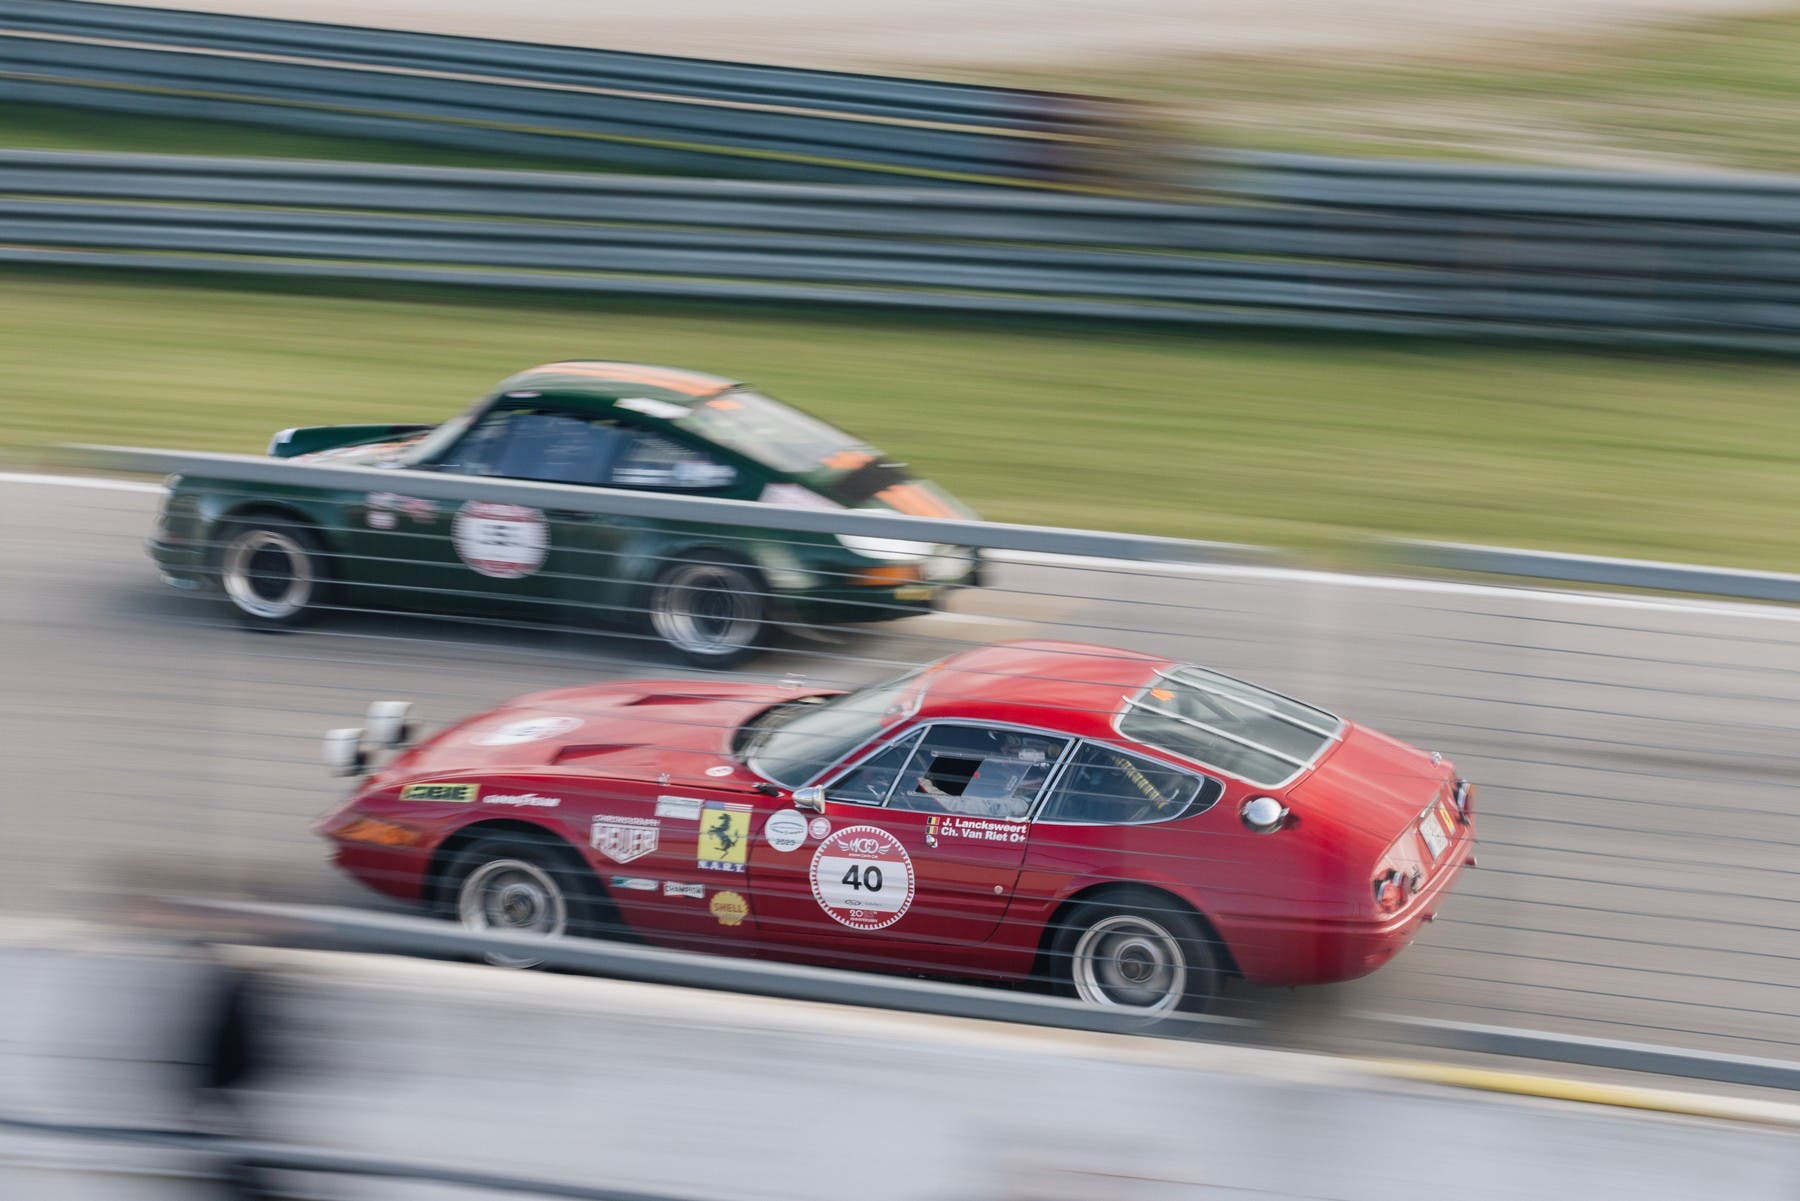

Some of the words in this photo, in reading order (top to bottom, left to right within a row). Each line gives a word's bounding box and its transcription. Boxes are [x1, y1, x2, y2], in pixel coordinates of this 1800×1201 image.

[940, 826, 959, 837] Ch.
[961, 828, 983, 840] Van
[984, 830, 1008, 842] Riet
[942, 817, 953, 827] J.
[955, 818, 1027, 834] Lancksweert
[592, 827, 656, 860] HEUER
[842, 864, 883, 892] 40
[713, 902, 744, 914] SHELL
